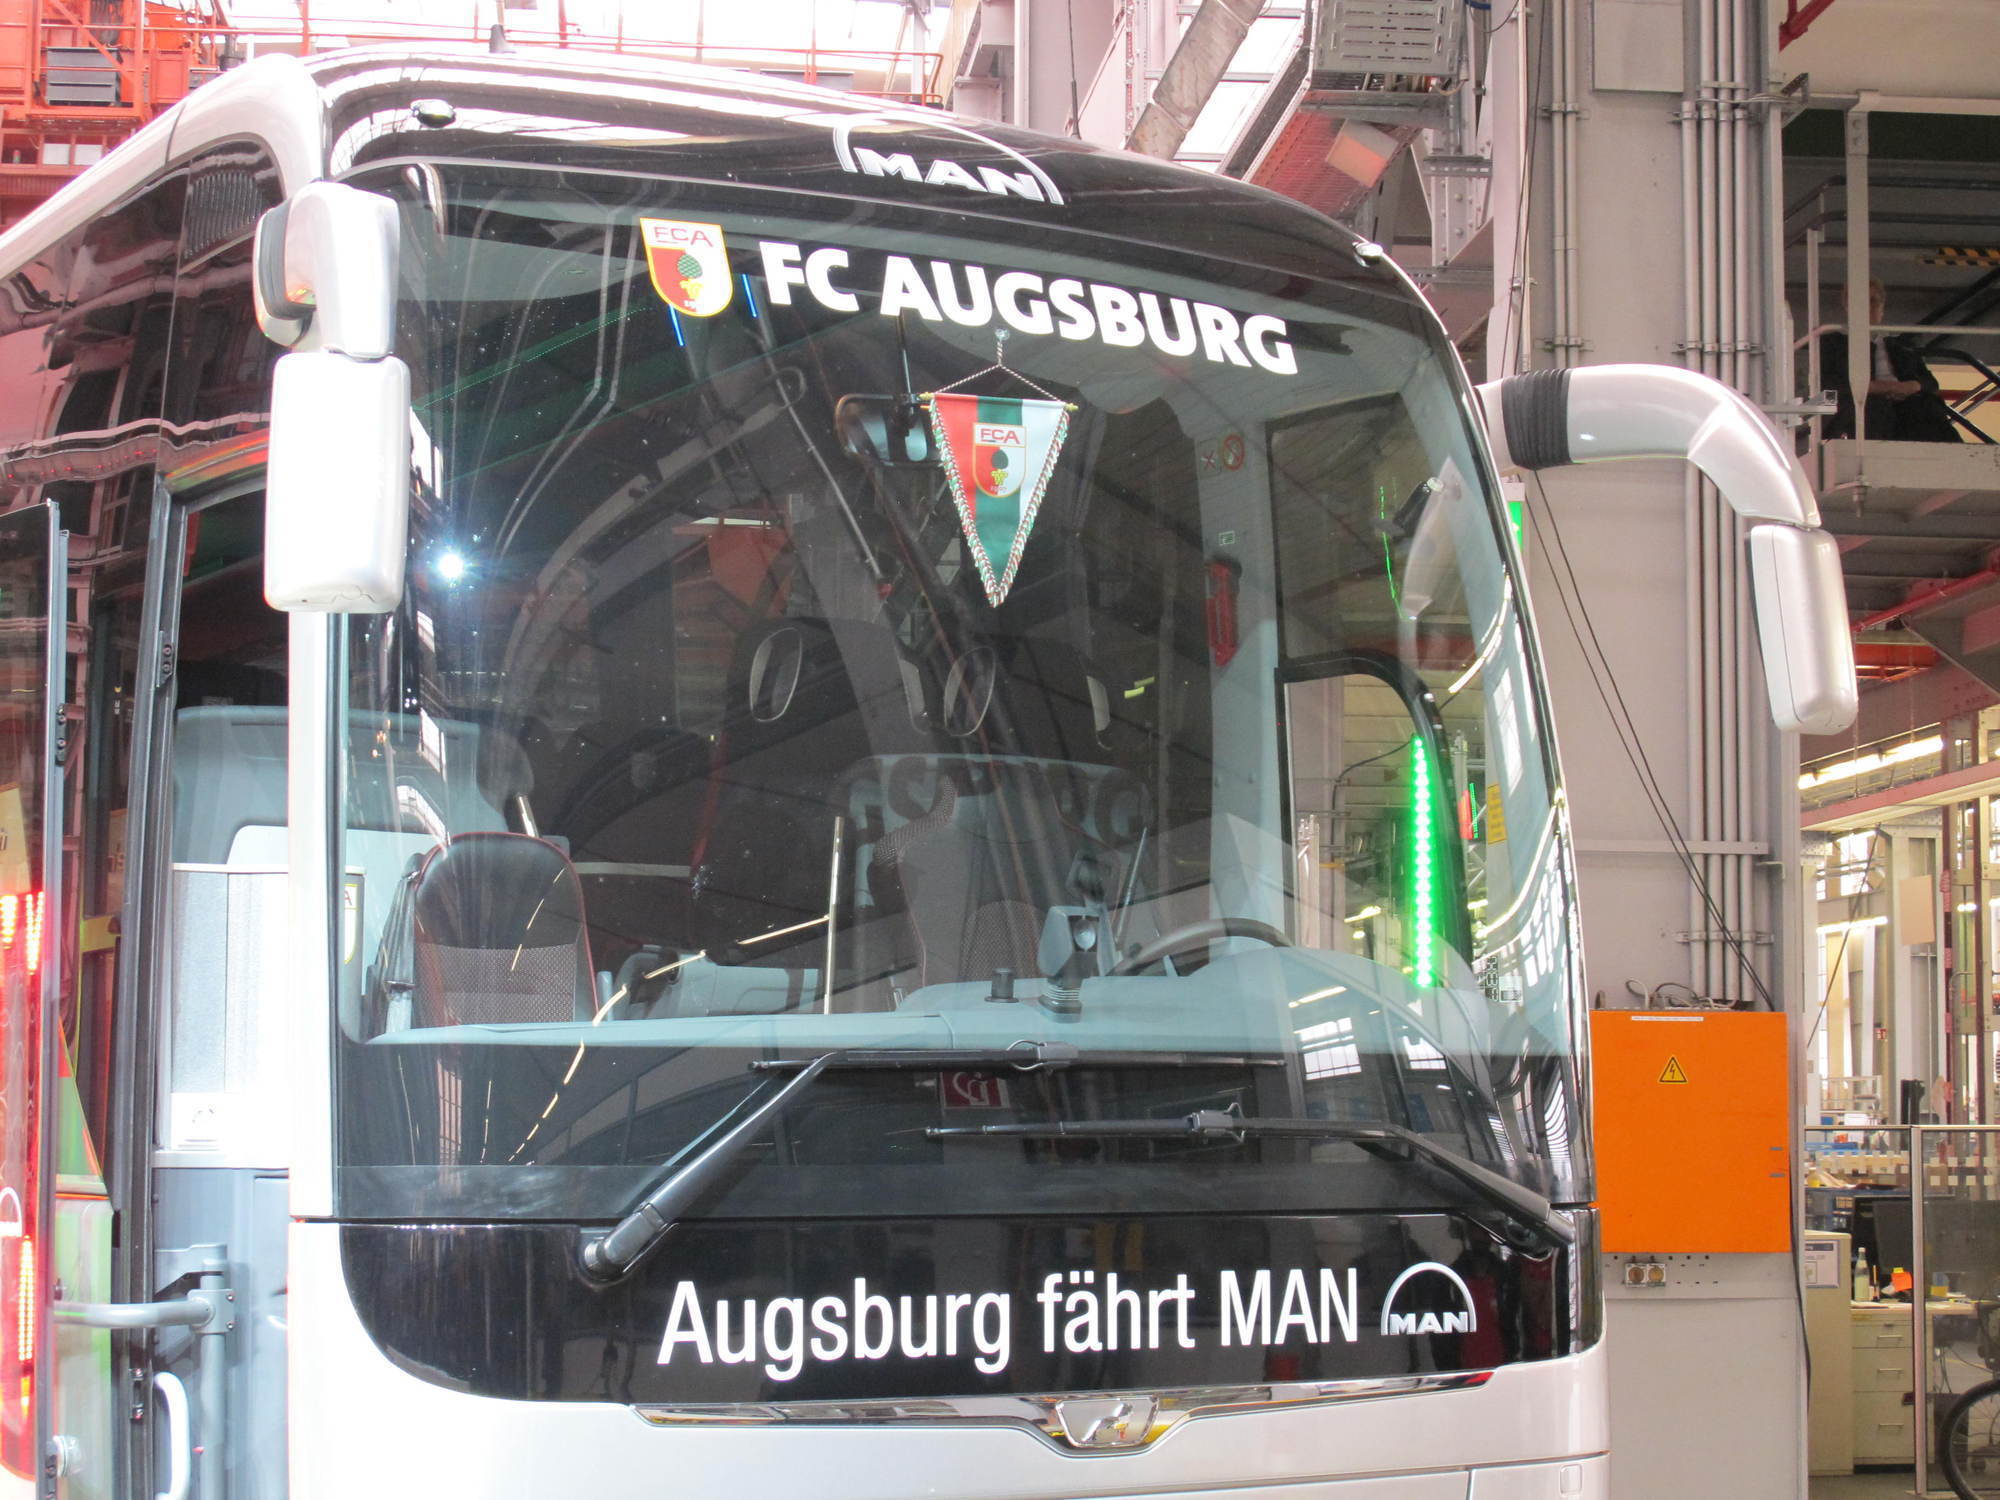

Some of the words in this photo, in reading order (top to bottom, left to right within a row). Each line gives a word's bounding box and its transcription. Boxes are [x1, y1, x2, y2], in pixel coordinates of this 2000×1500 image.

[853, 147, 1045, 203] MAN
[653, 226, 714, 248] FCA
[759, 241, 859, 311] FC
[880, 256, 1298, 375] AUGSBURG
[980, 428, 1021, 445] FCA
[656, 1277, 1010, 1381] Augsburg
[1036, 1270, 1196, 1353] fährt
[1220, 1267, 1358, 1346] MAN
[1389, 1311, 1469, 1336] MAN
